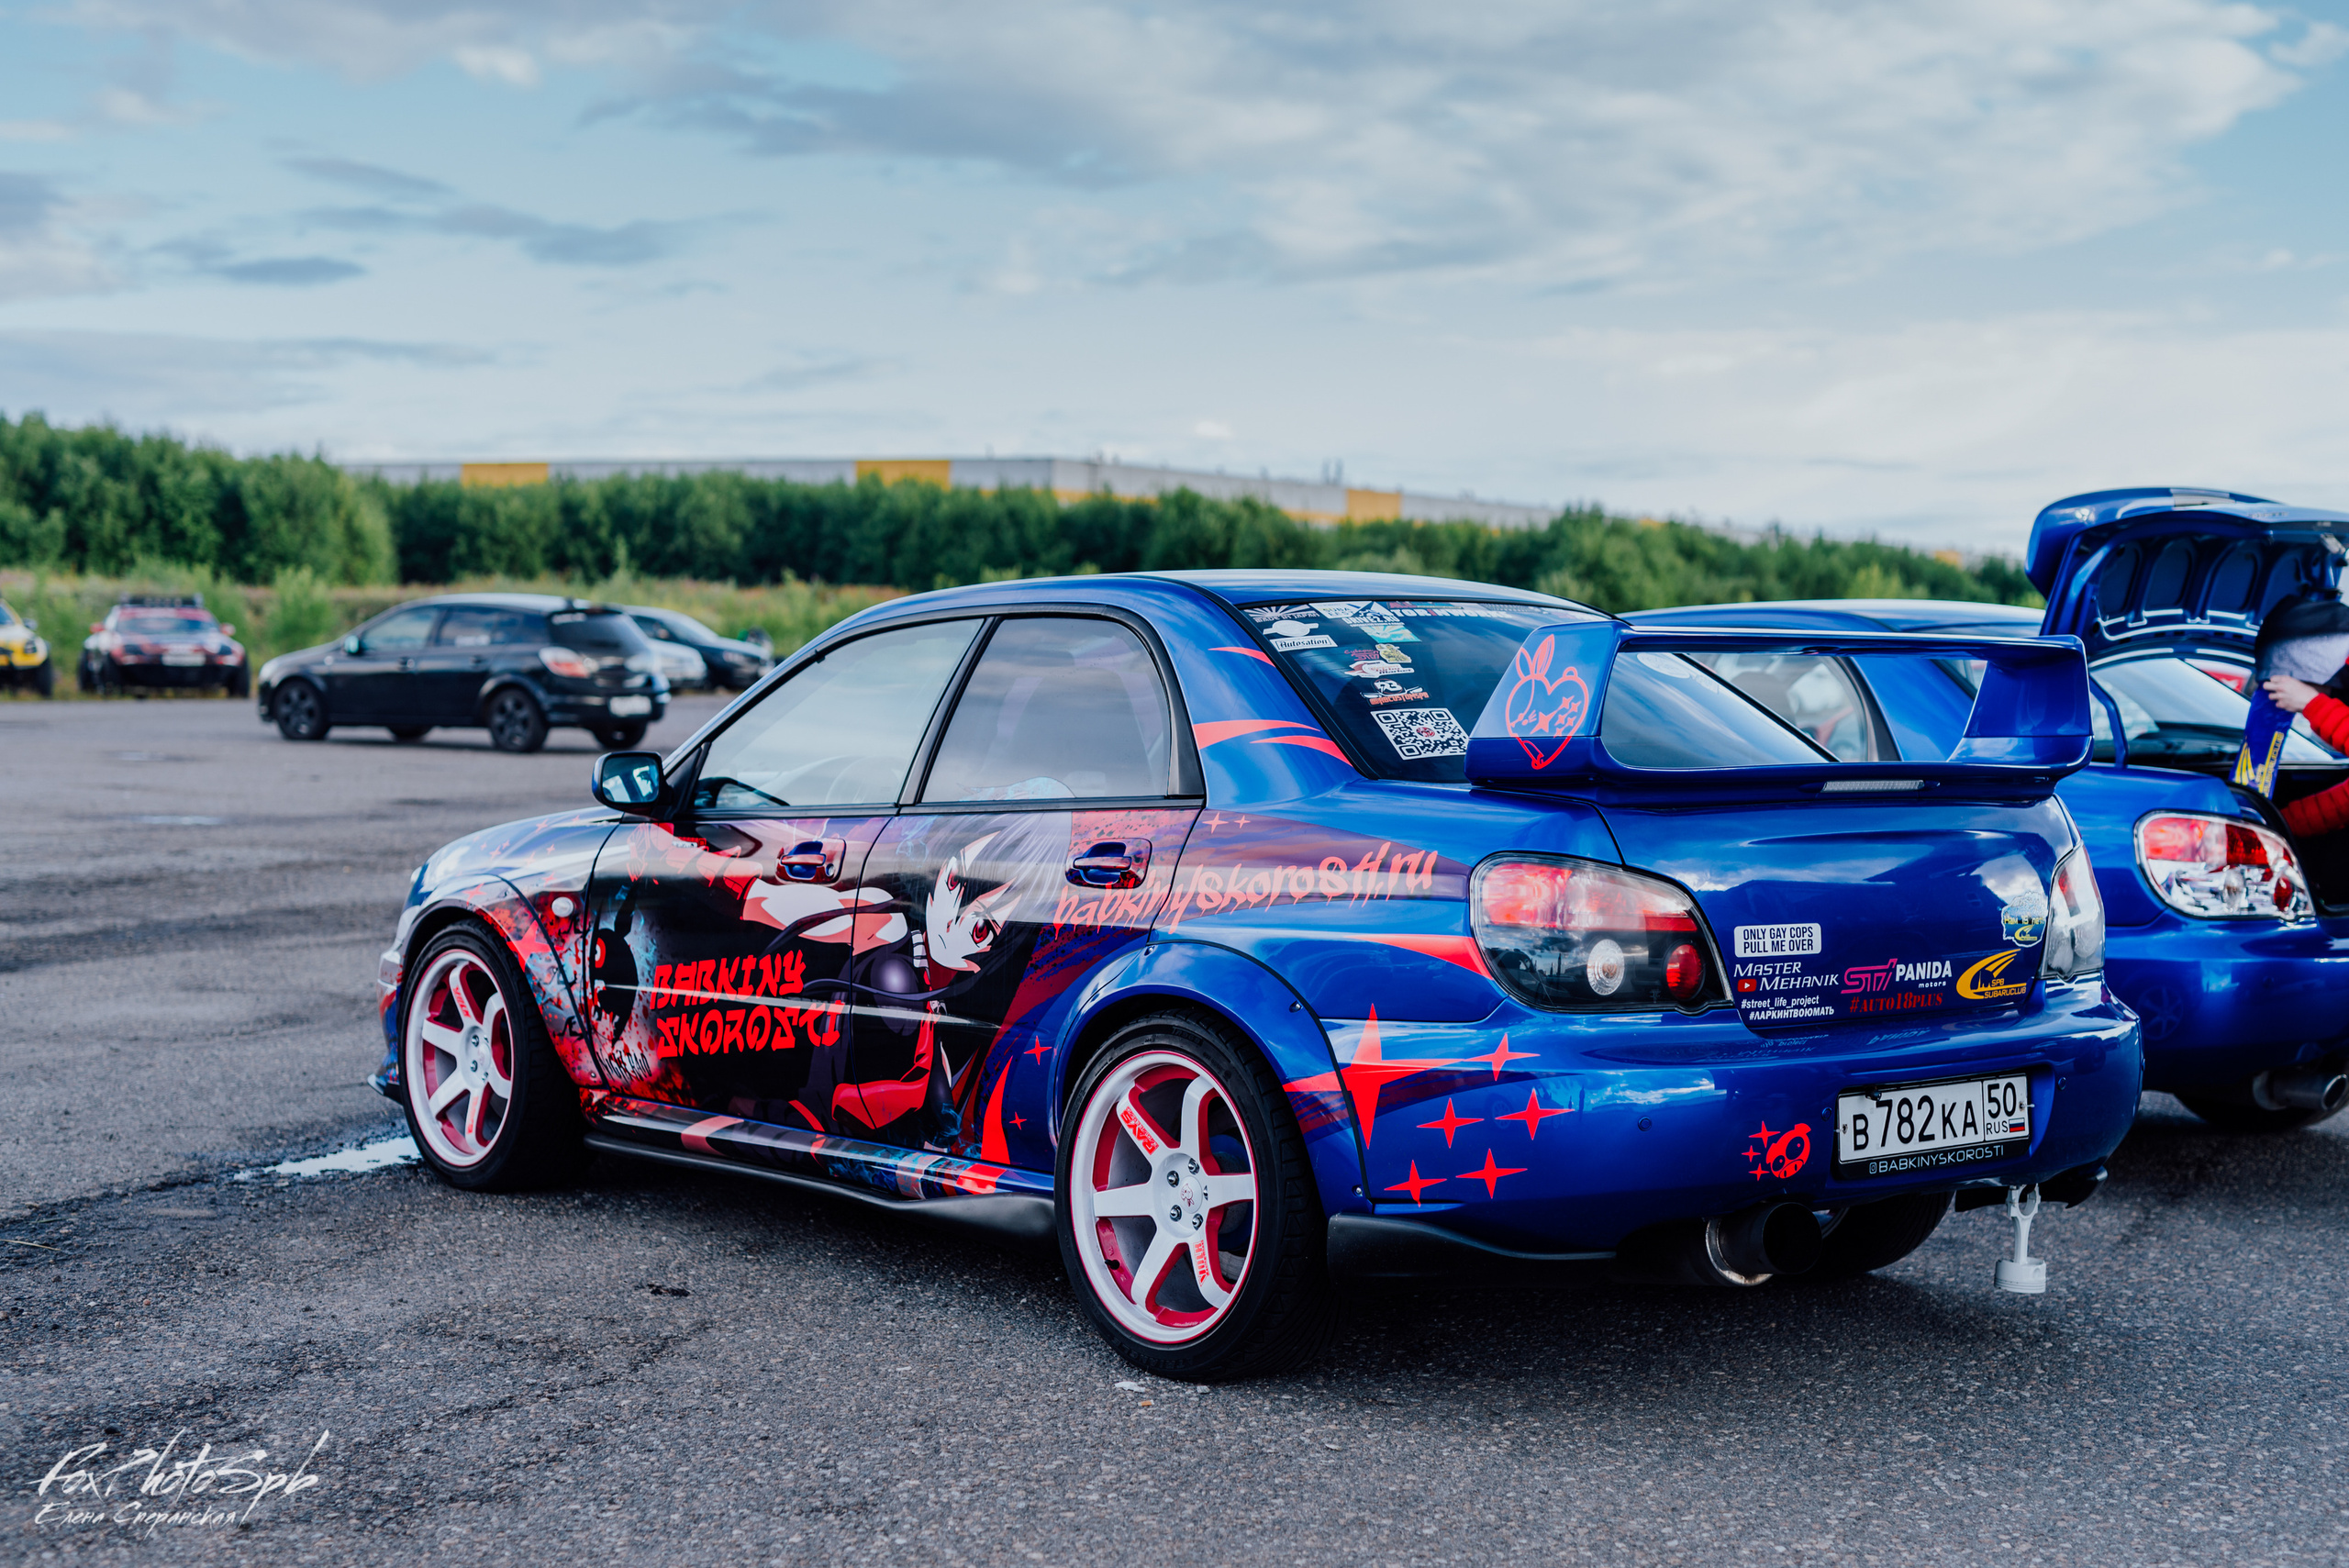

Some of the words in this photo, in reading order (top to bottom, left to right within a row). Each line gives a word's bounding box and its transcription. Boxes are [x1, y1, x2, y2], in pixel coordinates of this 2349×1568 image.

[1341, 615, 1400, 624] DRIVE2.RU
[1742, 928, 1766, 940] ONLY
[1769, 927, 1787, 940] GAY
[1789, 926, 1813, 939] COPS
[1743, 940, 1768, 953] PULL
[1771, 940, 1787, 952] ME
[1788, 939, 1813, 951] OVER
[1895, 960, 1953, 982] PANIDA
[650, 950, 807, 1010] BABKINY
[1919, 981, 1946, 989] motors
[1991, 978, 2005, 987] SPB
[1984, 986, 2027, 999] SUBARUCLUB
[1741, 995, 1820, 1010] #street_life_project
[656, 1000, 846, 1060] SKOROSTI
[1987, 1082, 2017, 1119] 50
[1119, 1109, 1157, 1156] RAYS
[1986, 1120, 2009, 1135] RUS
